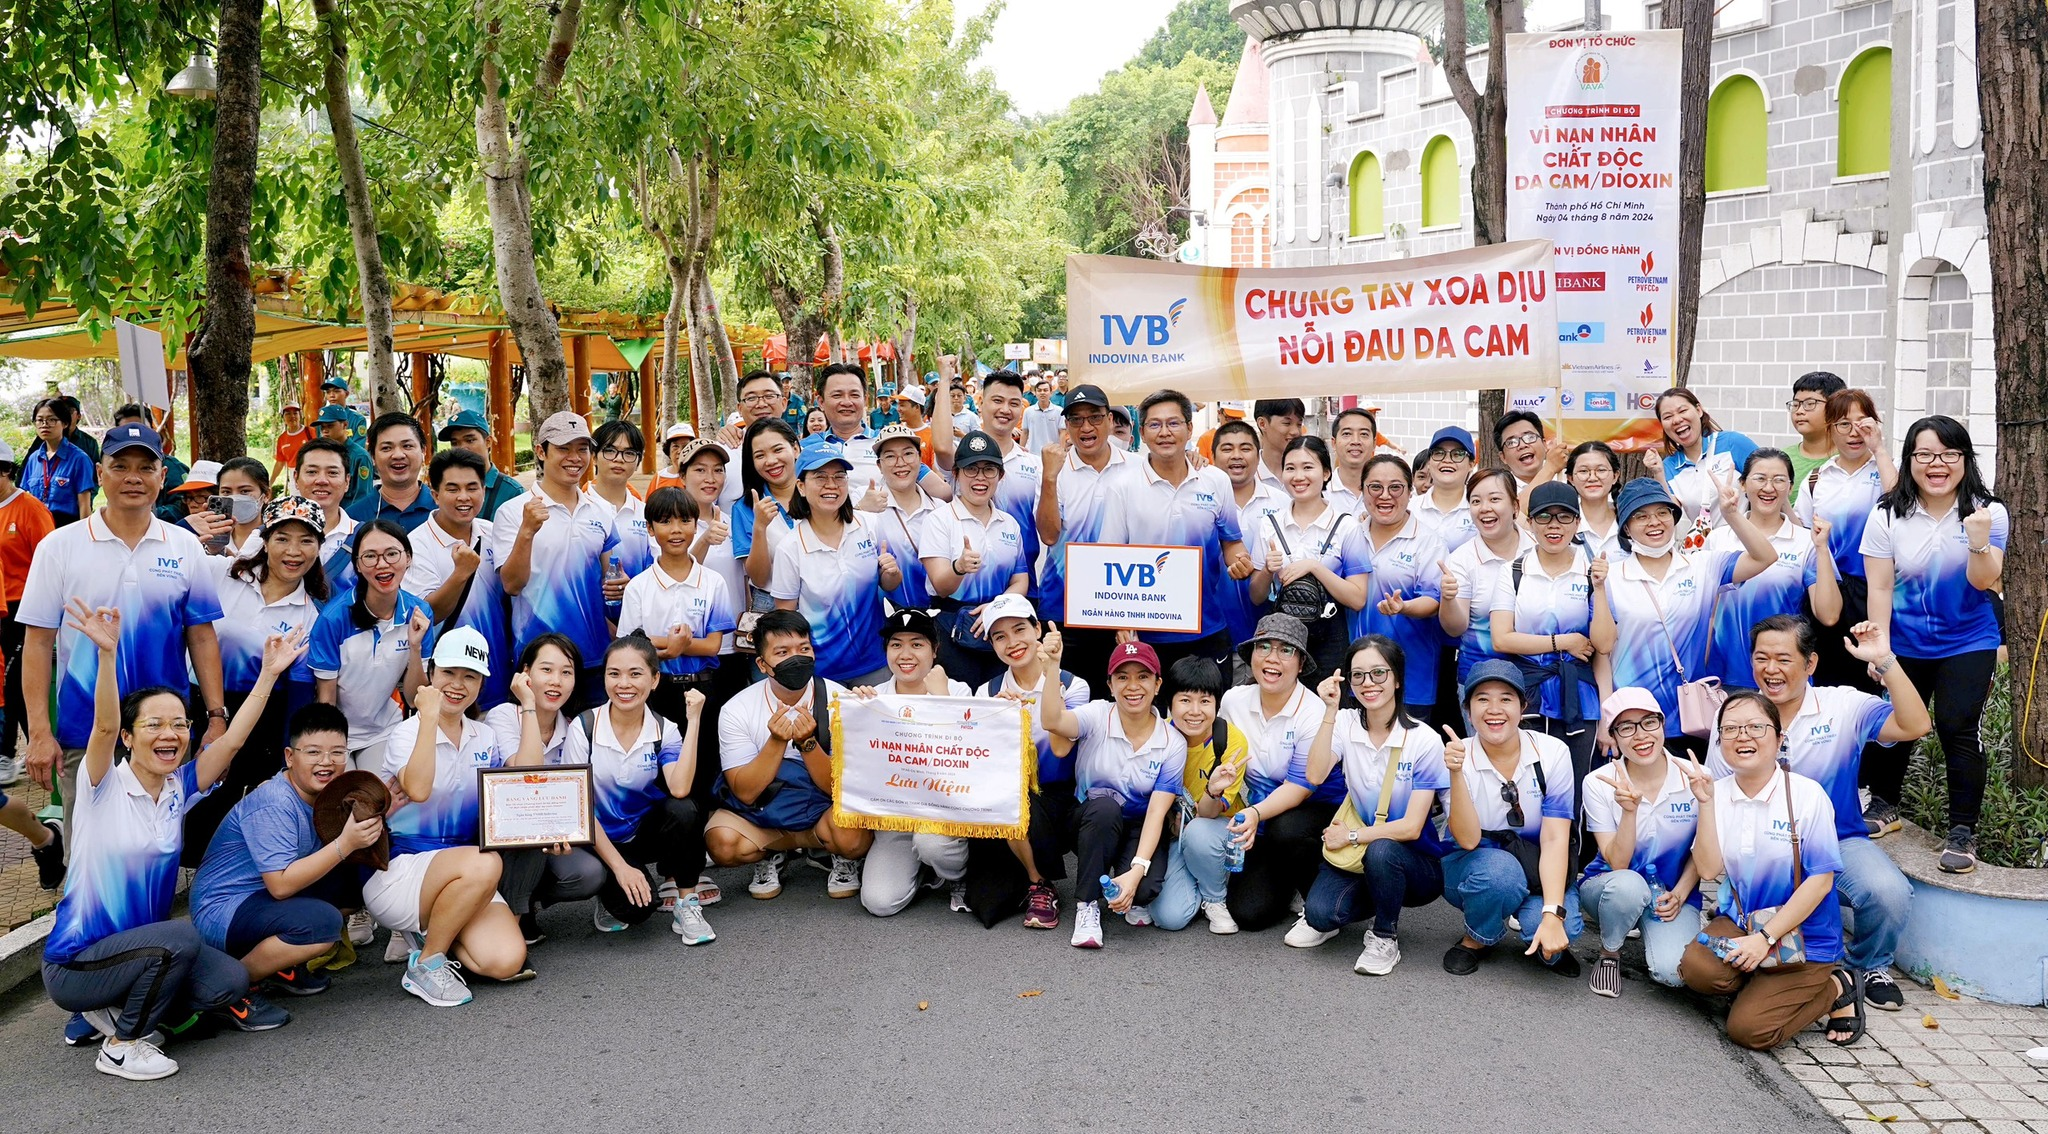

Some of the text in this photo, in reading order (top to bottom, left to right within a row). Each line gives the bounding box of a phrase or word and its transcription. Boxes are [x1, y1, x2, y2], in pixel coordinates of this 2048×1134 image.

[1549, 38, 1573, 48] ĐƠN
[1576, 38, 1586, 49] VỊ
[1605, 35, 1636, 46] CHỨC
[1580, 83, 1605, 91] VAVA
[1550, 107, 1583, 115] CHƯƠNG
[1586, 106, 1610, 114] TRÌNH
[1624, 106, 1635, 116] BỘ
[1529, 123, 1656, 148] VÌ NẠN NHÂN
[1543, 146, 1643, 171] CHẤT ĐỘC
[1515, 174, 1543, 191] DA
[1569, 201, 1589, 212] phố
[1606, 201, 1622, 210] Chí
[1623, 201, 1645, 210] Minh
[1536, 213, 1654, 224] Ngày 04 tháng 8 năm 2024
[1564, 247, 1574, 258] VỊ
[1577, 243, 1609, 255] ĐỒNG
[1612, 244, 1640, 255] HÀNH
[1628, 276, 1668, 284] PETROVIETNAM
[1245, 270, 1546, 320] CHUNG TAY XOA DỊU
[1100, 314, 1170, 346] IVB
[1627, 328, 1667, 336] PETROVIETNAM
[1278, 321, 1529, 365] NỖI ĐAU DA CAM
[1089, 353, 1185, 364] INDOVINA BANK
[1196, 493, 1213, 502] IVB
[157, 557, 179, 569] IVB
[1103, 562, 1156, 588] IVB
[1094, 591, 1167, 602] INDOVINA BANK
[1082, 609, 1182, 621] NGÂN HÀNG TNHH INDOVINA
[1811, 724, 1831, 736] IVB
[869, 738, 990, 760] VÌ NẠN NHÂN CHẤT ĐỘC
[888, 753, 902, 763] DA
[885, 773, 971, 797] Lưu Niệm
[1670, 802, 1691, 812] IVB
